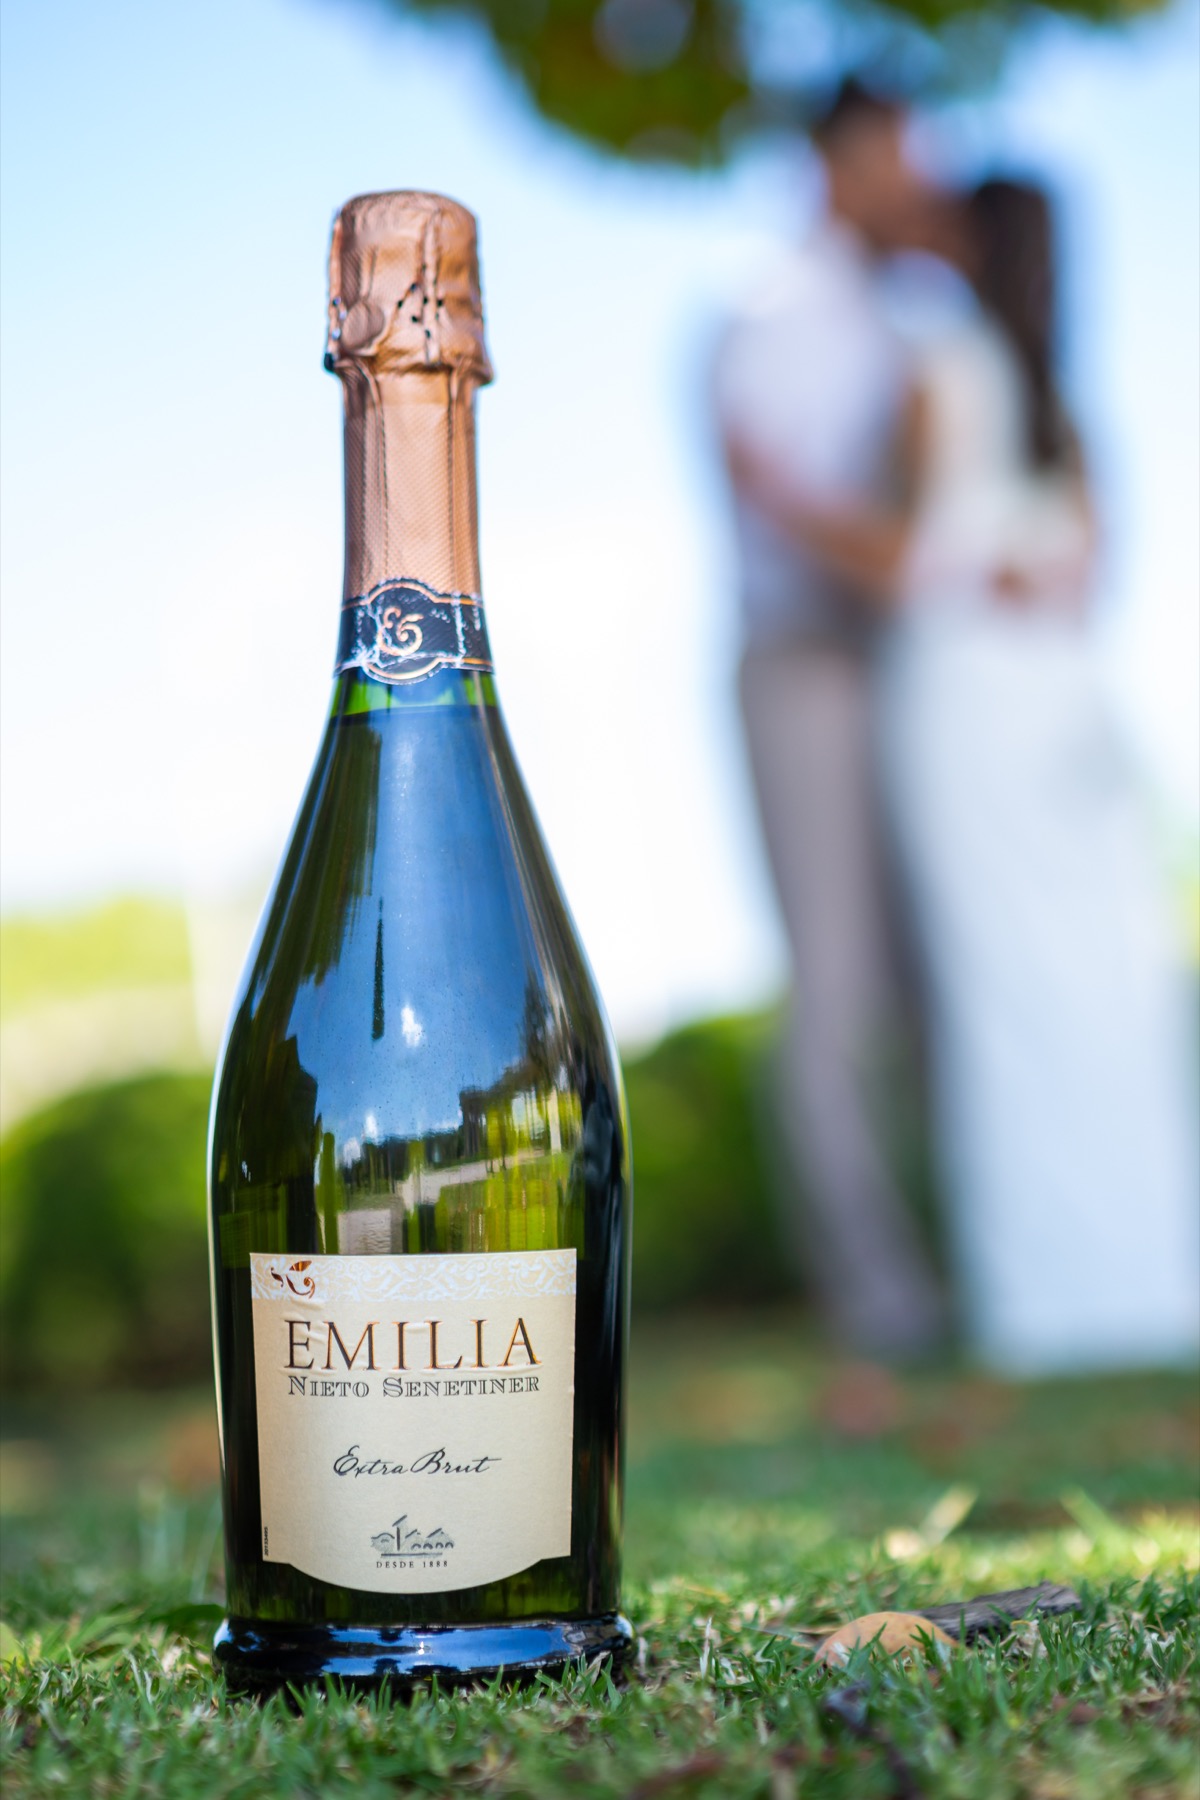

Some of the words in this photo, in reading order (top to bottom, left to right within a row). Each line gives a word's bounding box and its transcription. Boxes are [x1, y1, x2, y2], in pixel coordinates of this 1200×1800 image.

[284, 1317, 543, 1370] EMILIA
[288, 1375, 369, 1398] NIETO
[383, 1376, 540, 1398] SENETINER
[333, 1445, 408, 1478] Extra
[410, 1446, 502, 1475] Brut
[376, 1561, 415, 1569] DESDE
[422, 1560, 448, 1568] 1888
